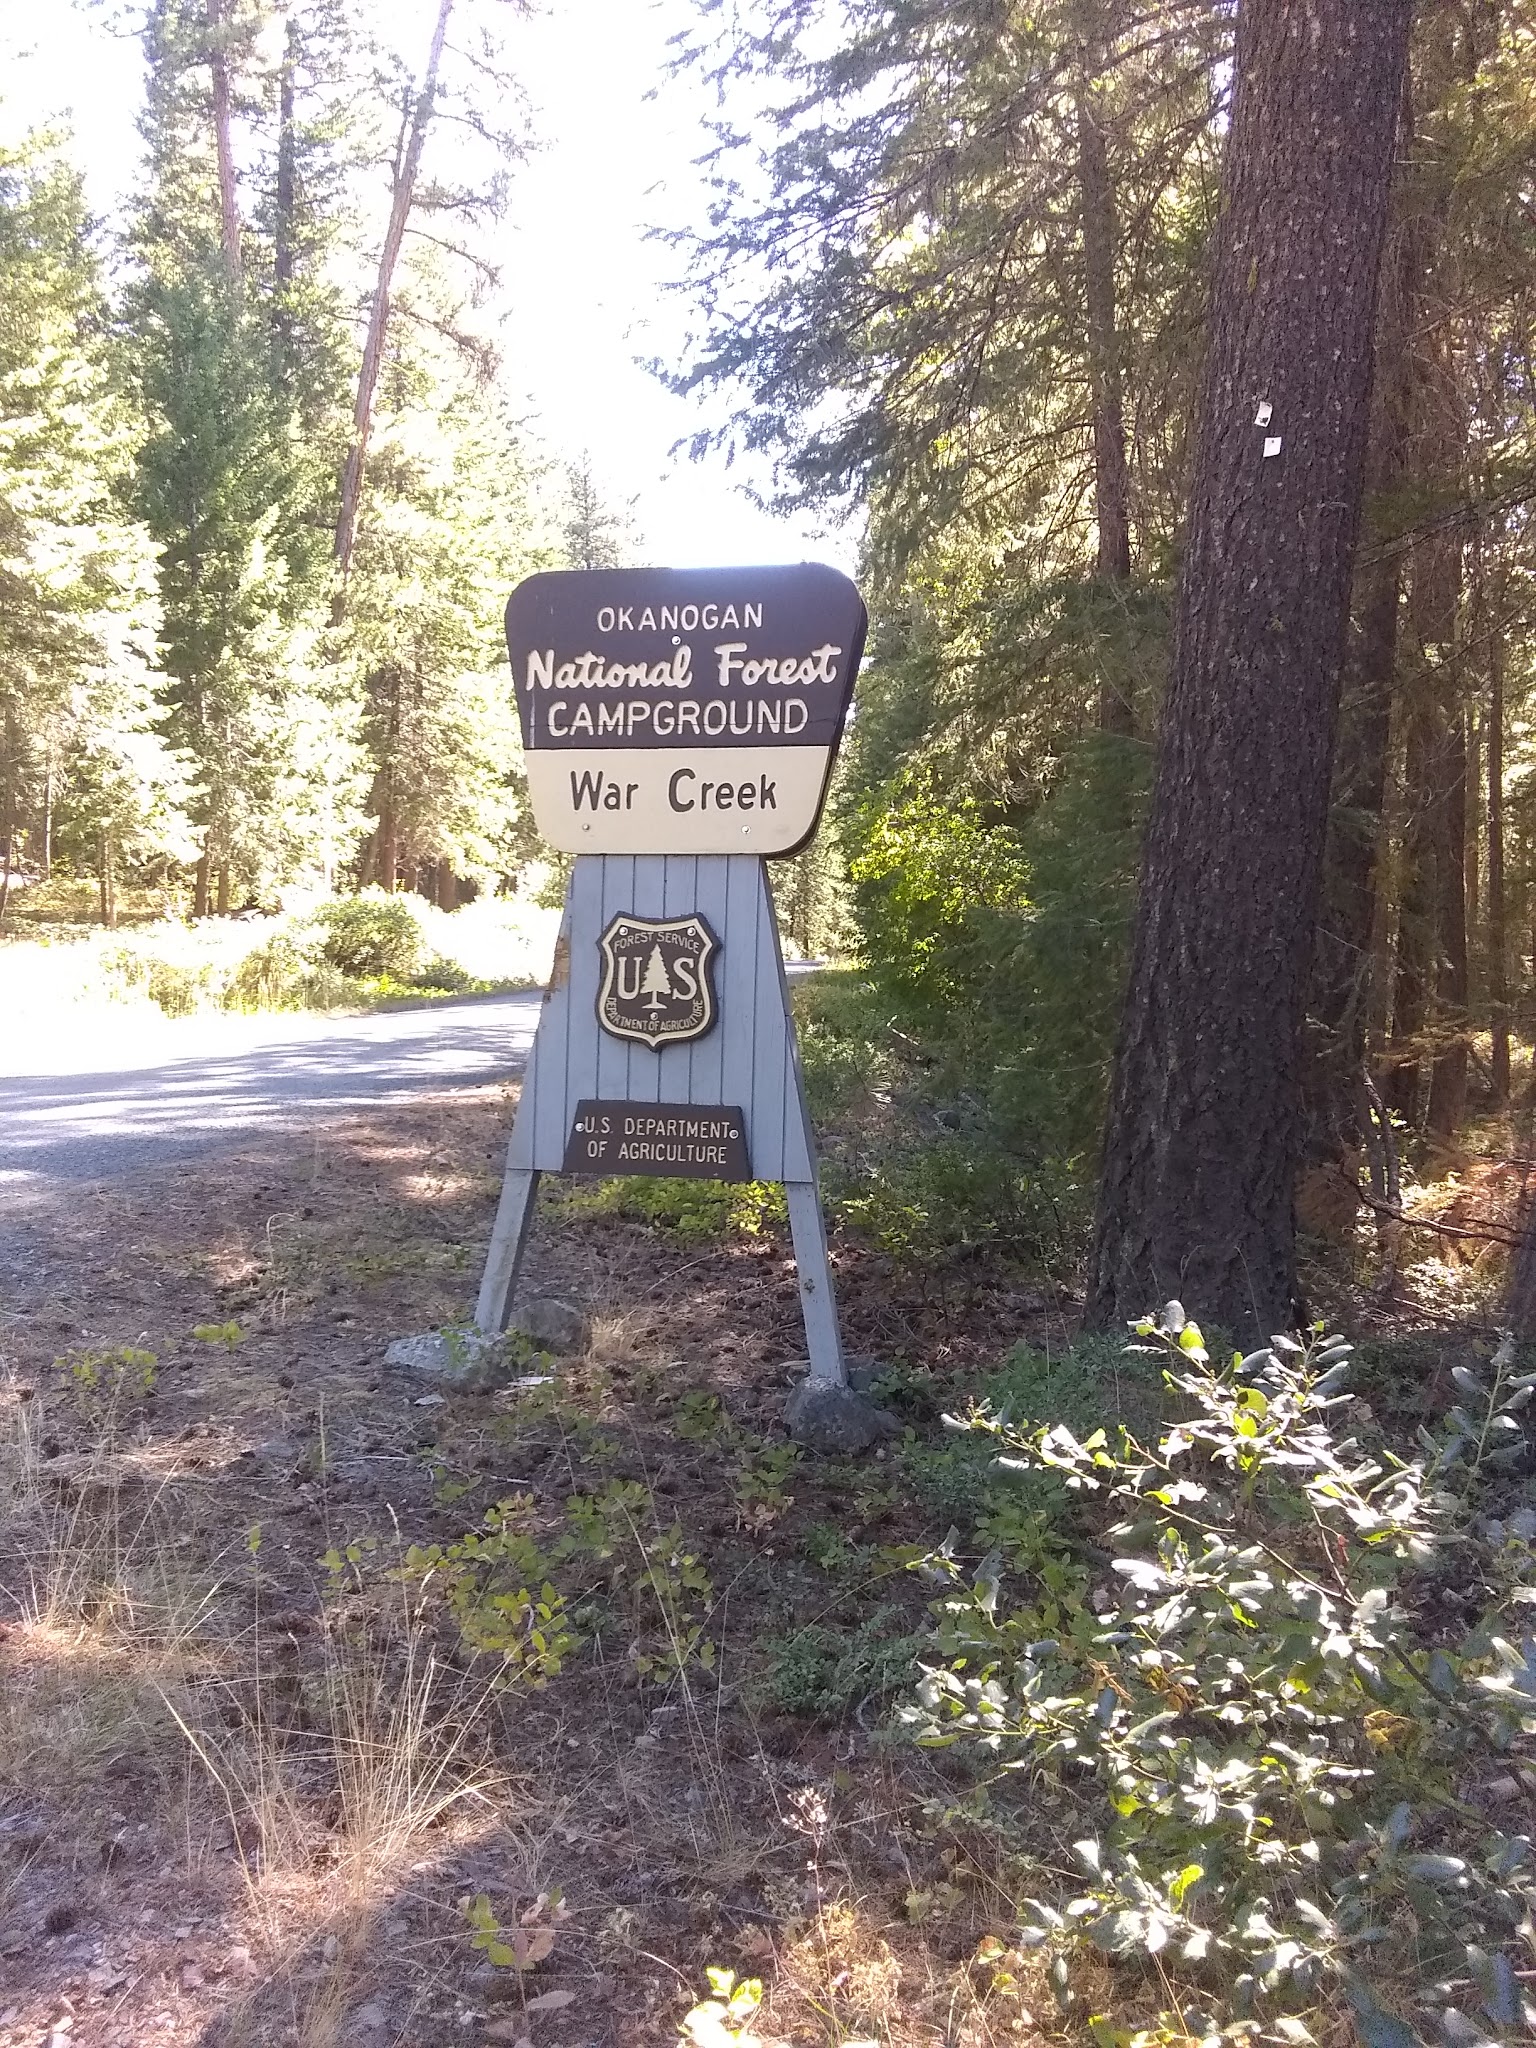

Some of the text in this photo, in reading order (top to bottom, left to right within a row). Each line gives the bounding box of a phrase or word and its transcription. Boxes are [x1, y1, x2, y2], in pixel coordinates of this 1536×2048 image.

[597, 602, 763, 632] OKANOGAN
[526, 642, 842, 691] National Forest
[548, 699, 808, 737] CAMPGROUND
[570, 768, 777, 813] War Creek
[614, 932, 700, 954] FOREST SERVICE
[606, 997, 703, 1031] DEPARTMENT OF AGRICULTURE
[584, 1116, 730, 1138] U.S. DEPARTMENT
[587, 1140, 727, 1164] OF AGRICULTURE
